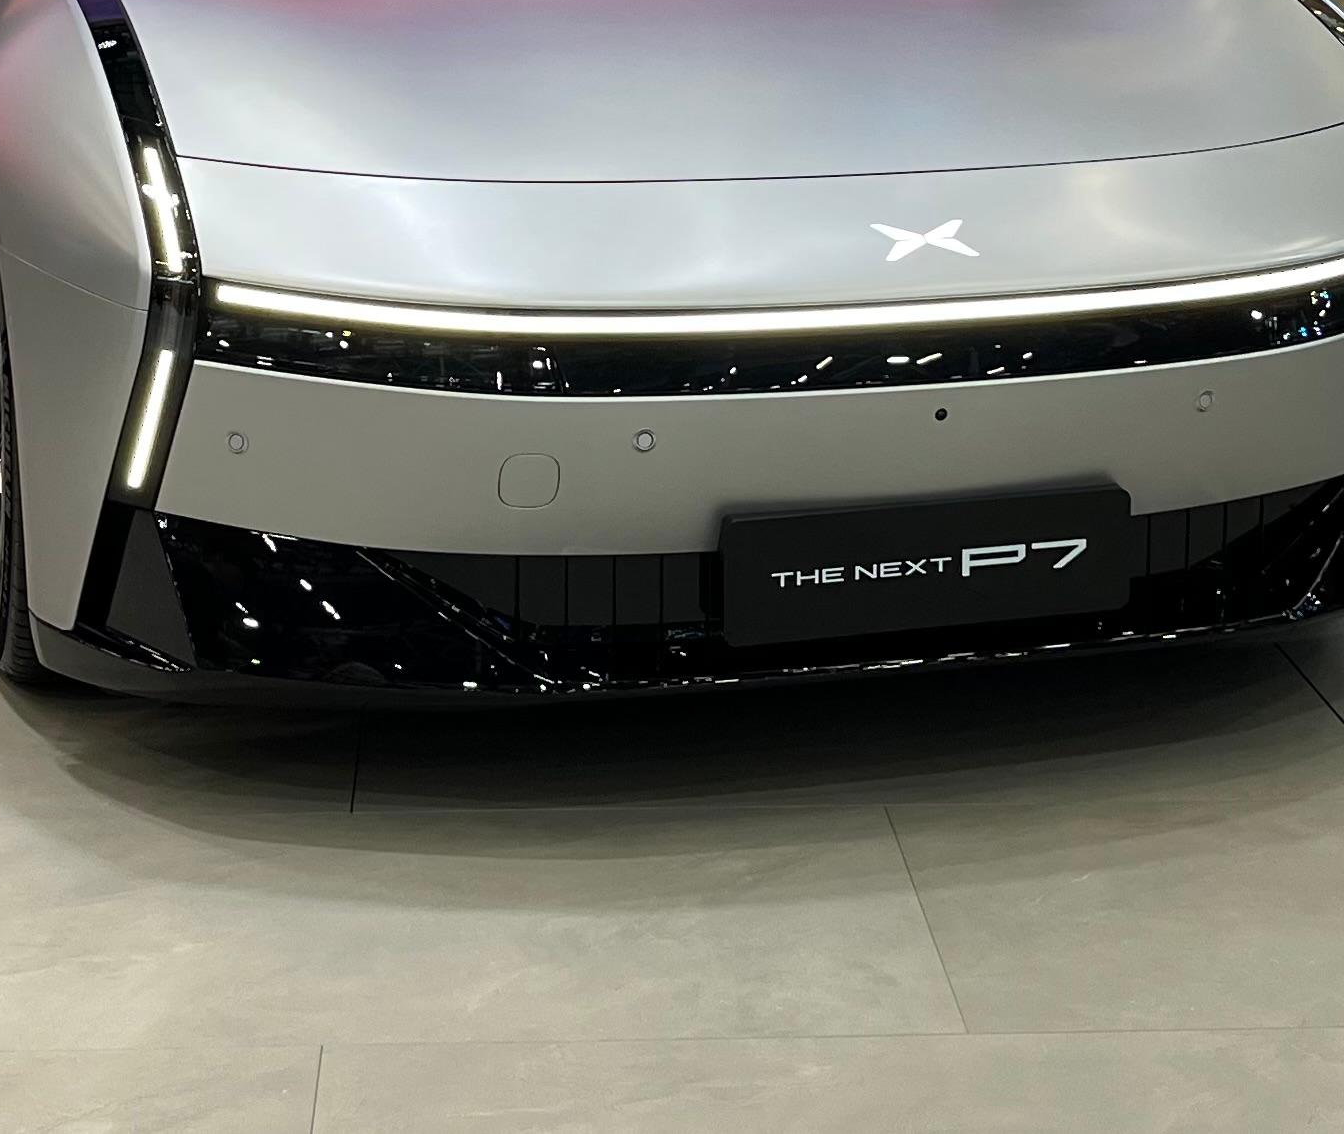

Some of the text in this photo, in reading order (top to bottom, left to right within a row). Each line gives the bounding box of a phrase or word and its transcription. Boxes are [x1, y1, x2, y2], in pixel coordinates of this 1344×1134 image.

[772, 539, 1086, 587] THE NEXT P7
